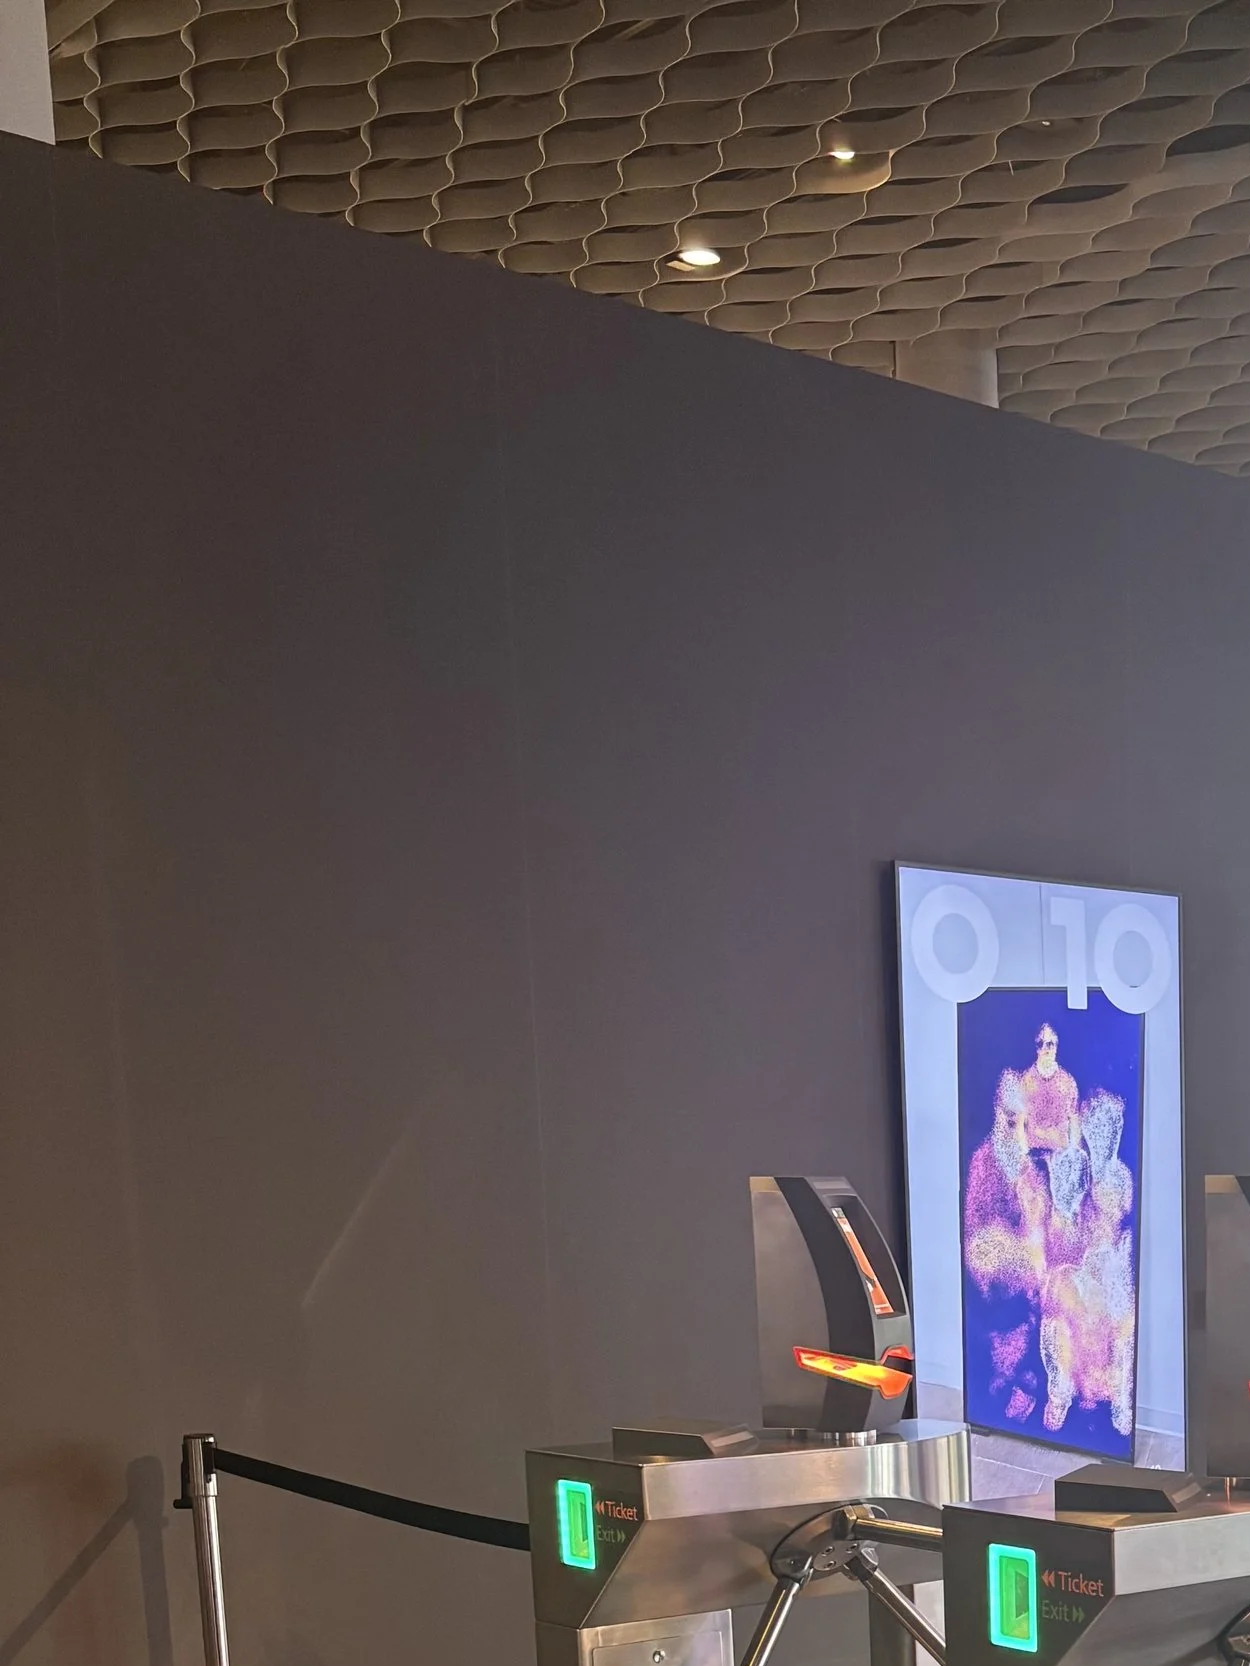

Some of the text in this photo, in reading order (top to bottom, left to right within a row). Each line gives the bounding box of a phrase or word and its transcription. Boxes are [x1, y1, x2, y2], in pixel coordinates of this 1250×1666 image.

[1051, 897, 1171, 1014] 10
[605, 1501, 638, 1521] Ticket
[597, 1525, 615, 1543] Exit
[1058, 1572, 1105, 1597] Ticket
[1041, 1600, 1070, 1623] Exit
